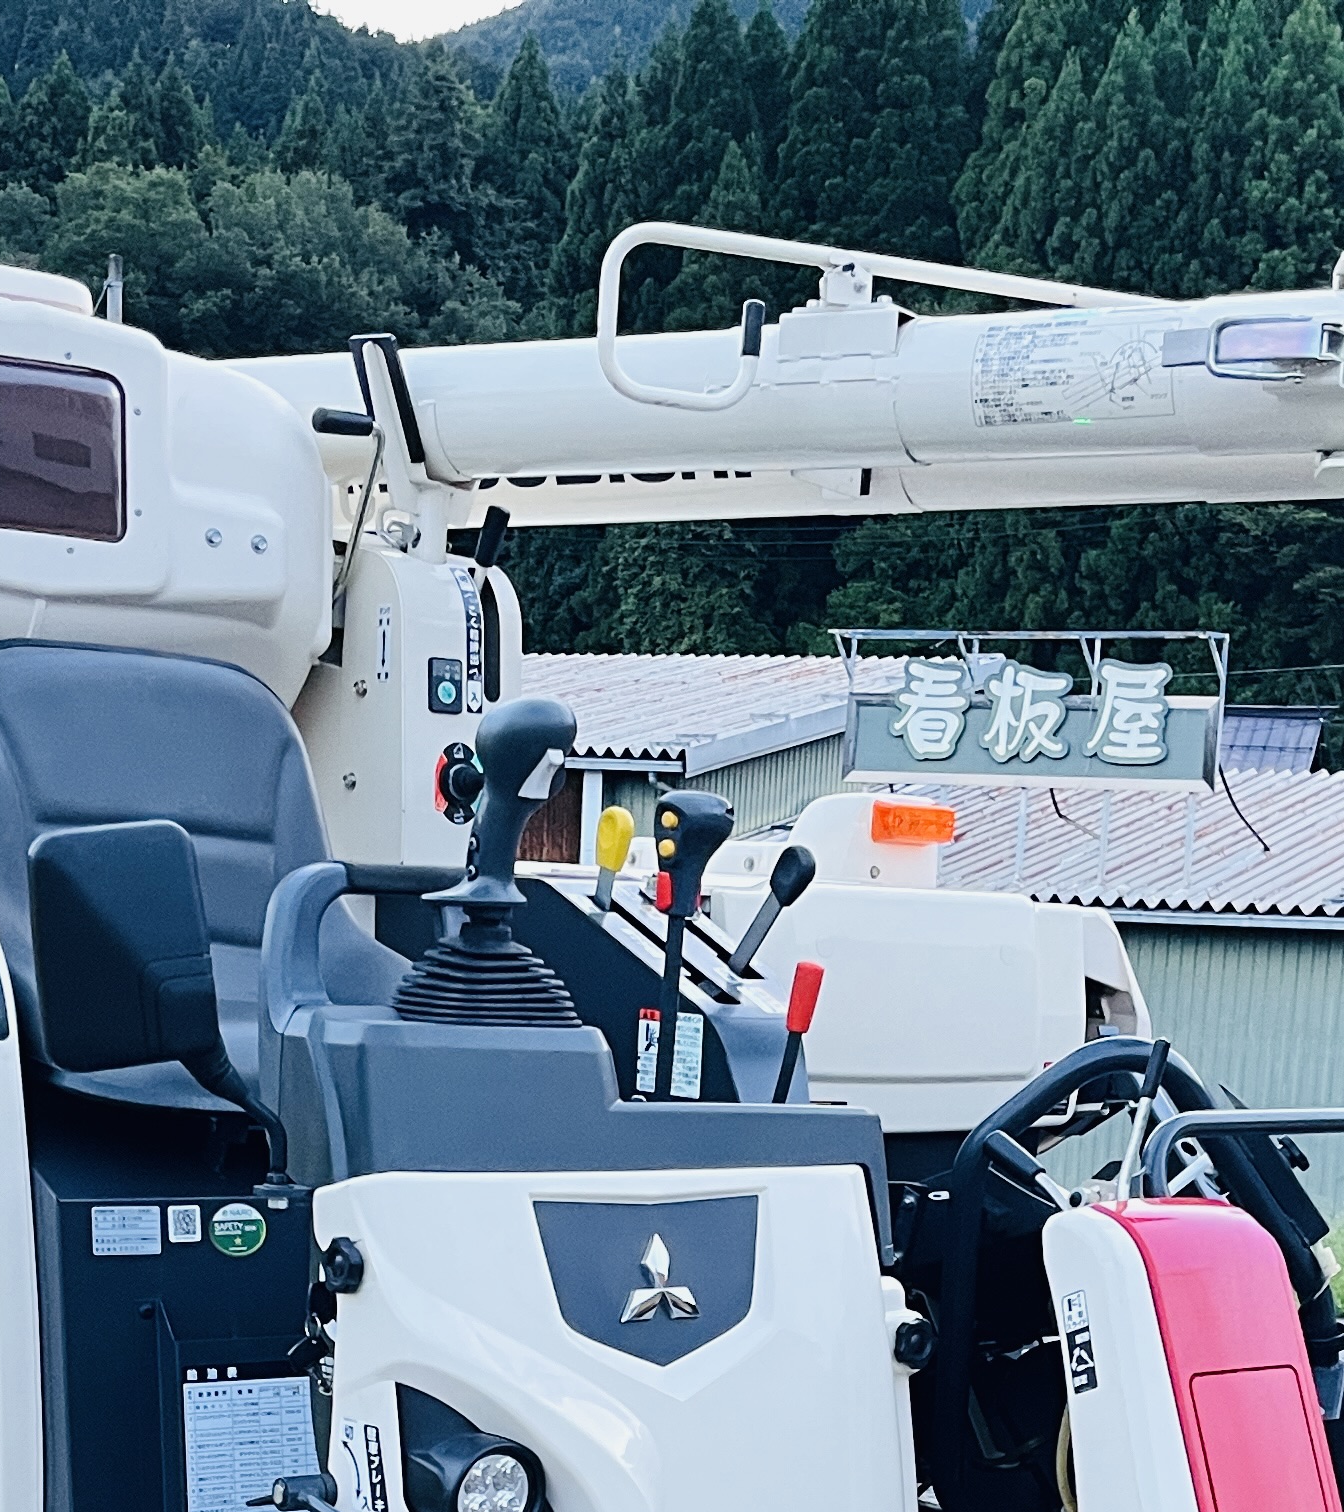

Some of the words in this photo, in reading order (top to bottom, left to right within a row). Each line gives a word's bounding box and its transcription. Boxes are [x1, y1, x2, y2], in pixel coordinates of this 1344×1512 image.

[891, 659, 1170, 761] 看板屋
[213, 1221, 244, 1232] SAFETY
